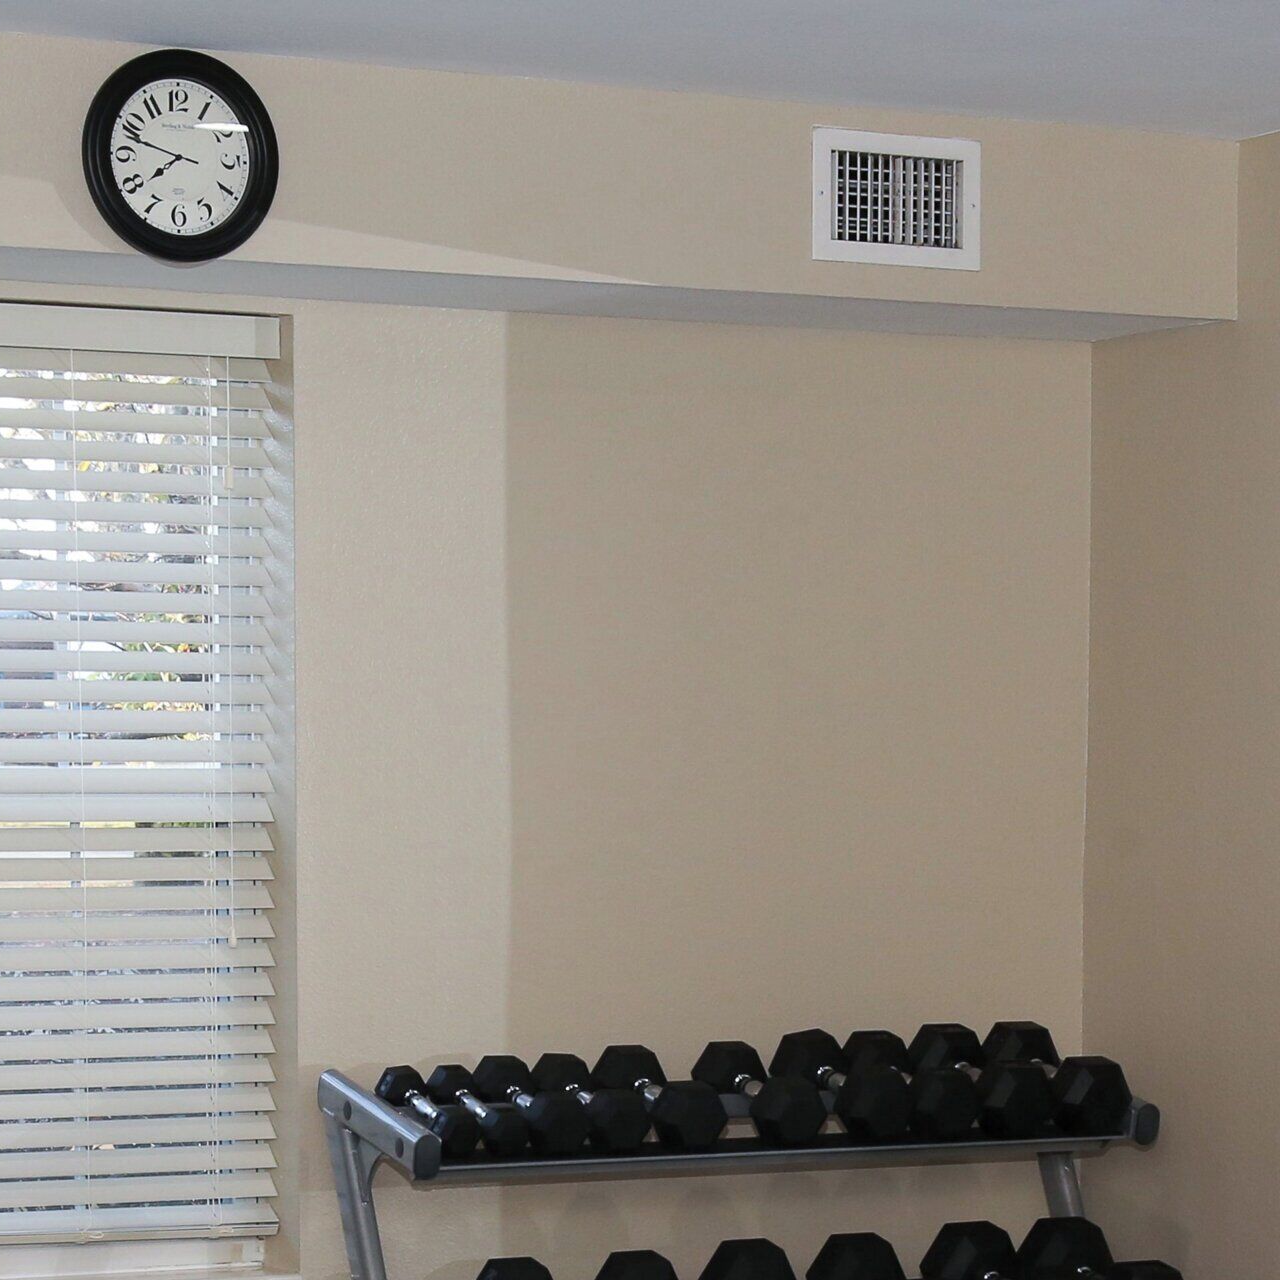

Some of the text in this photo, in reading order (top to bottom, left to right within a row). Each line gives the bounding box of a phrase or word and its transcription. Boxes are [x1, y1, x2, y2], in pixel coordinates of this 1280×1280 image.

[143, 94, 163, 119] 11
[168, 90, 189, 112] 12
[197, 101, 211, 121] 1
[122, 112, 146, 138] 10
[115, 145, 137, 164] 9
[220, 152, 241, 171] 3
[122, 173, 144, 195] 8
[215, 180, 236, 202] 4
[144, 194, 163, 214] 7
[171, 203, 187, 227] 6
[197, 197, 213, 223] 5
